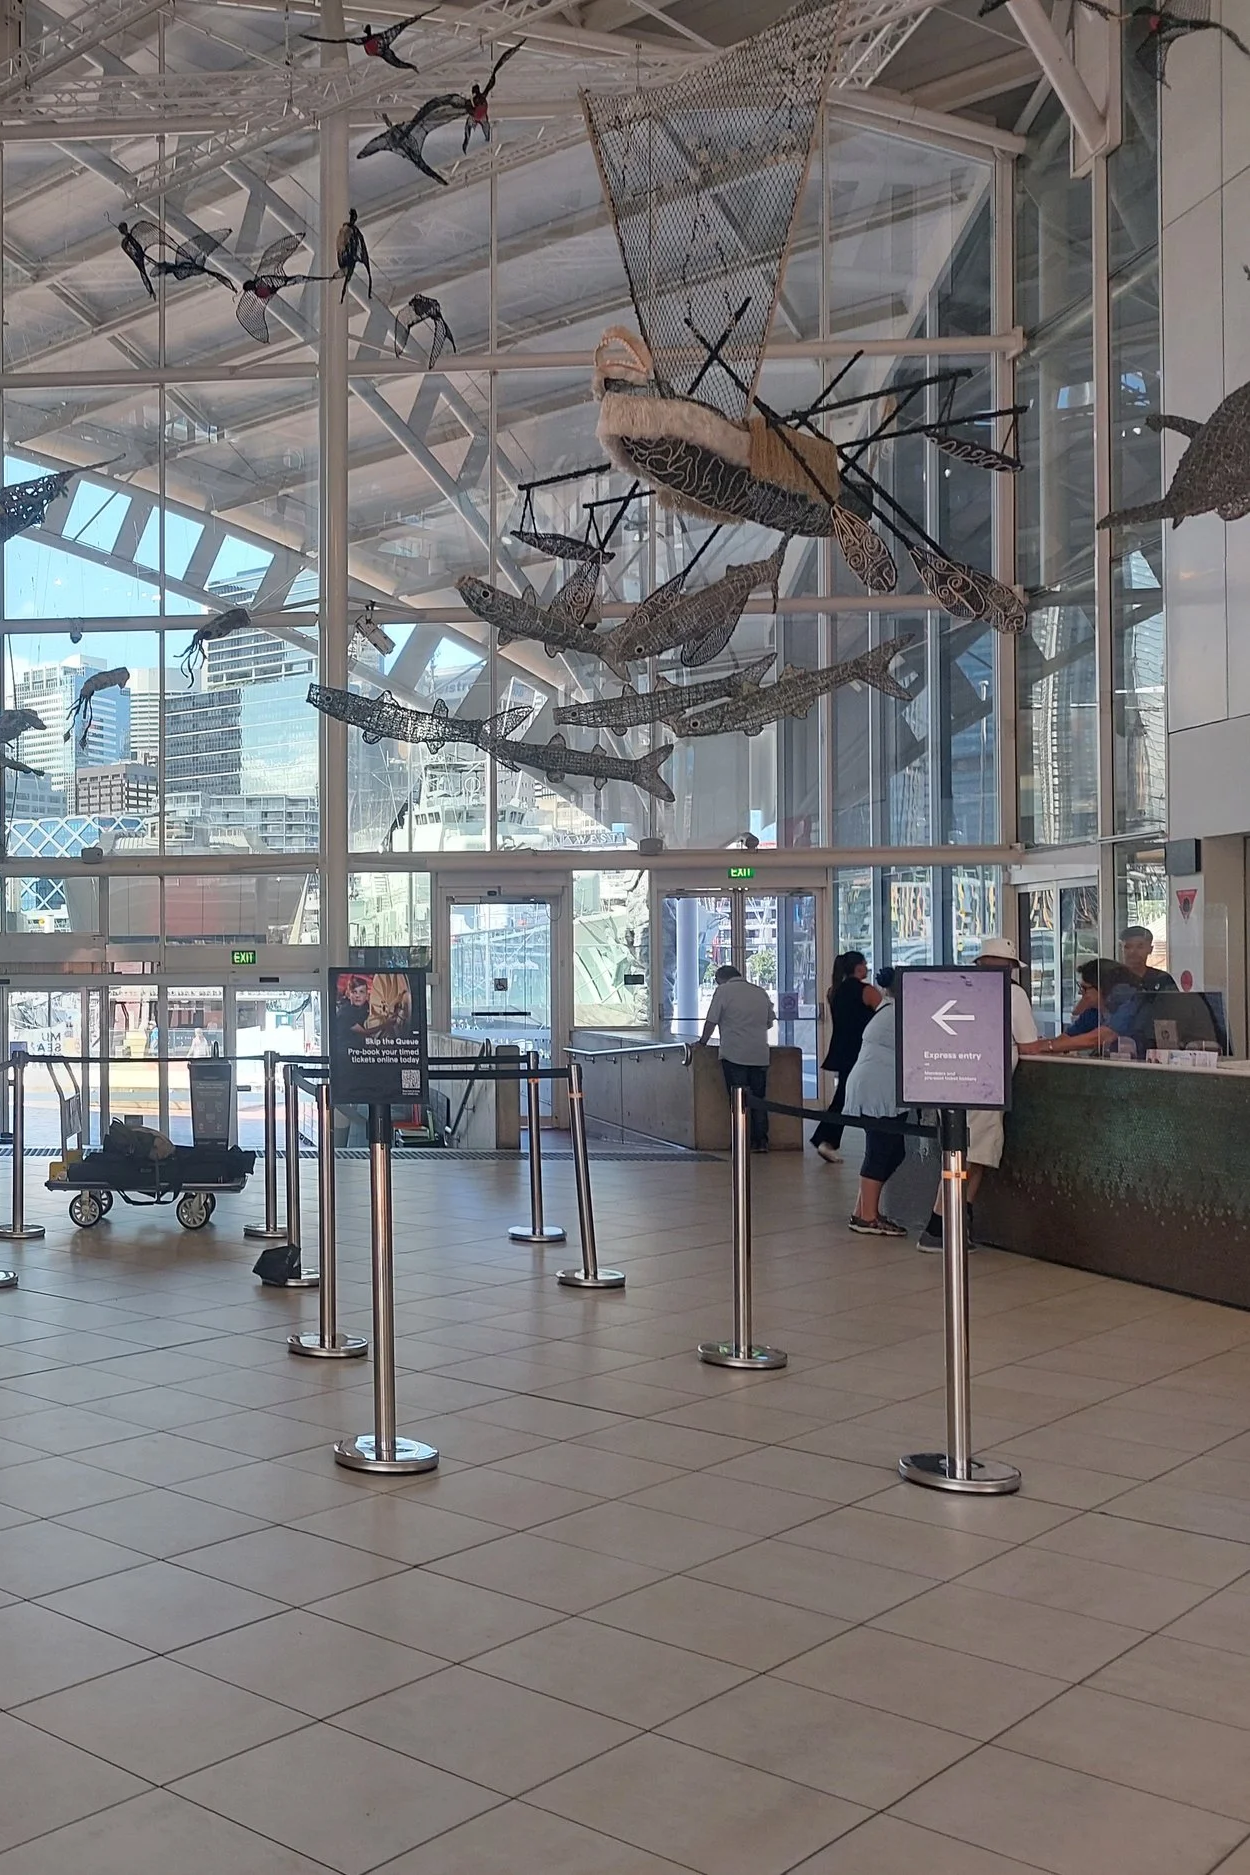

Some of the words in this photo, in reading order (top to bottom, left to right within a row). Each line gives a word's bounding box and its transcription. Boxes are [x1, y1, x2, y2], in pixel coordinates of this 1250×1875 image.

[731, 868, 750, 877] EXIT
[233, 952, 254, 963] EXIT
[365, 1037, 381, 1046] Skip
[382, 1037, 394, 1045] the
[395, 1037, 419, 1045] Queue
[348, 1048, 380, 1056] Pre-book
[381, 1049, 398, 1057] your
[399, 1048, 420, 1056] timed
[924, 1051, 956, 1061] Express
[958, 1052, 981, 1061] entry
[400, 1056, 420, 1064] today
